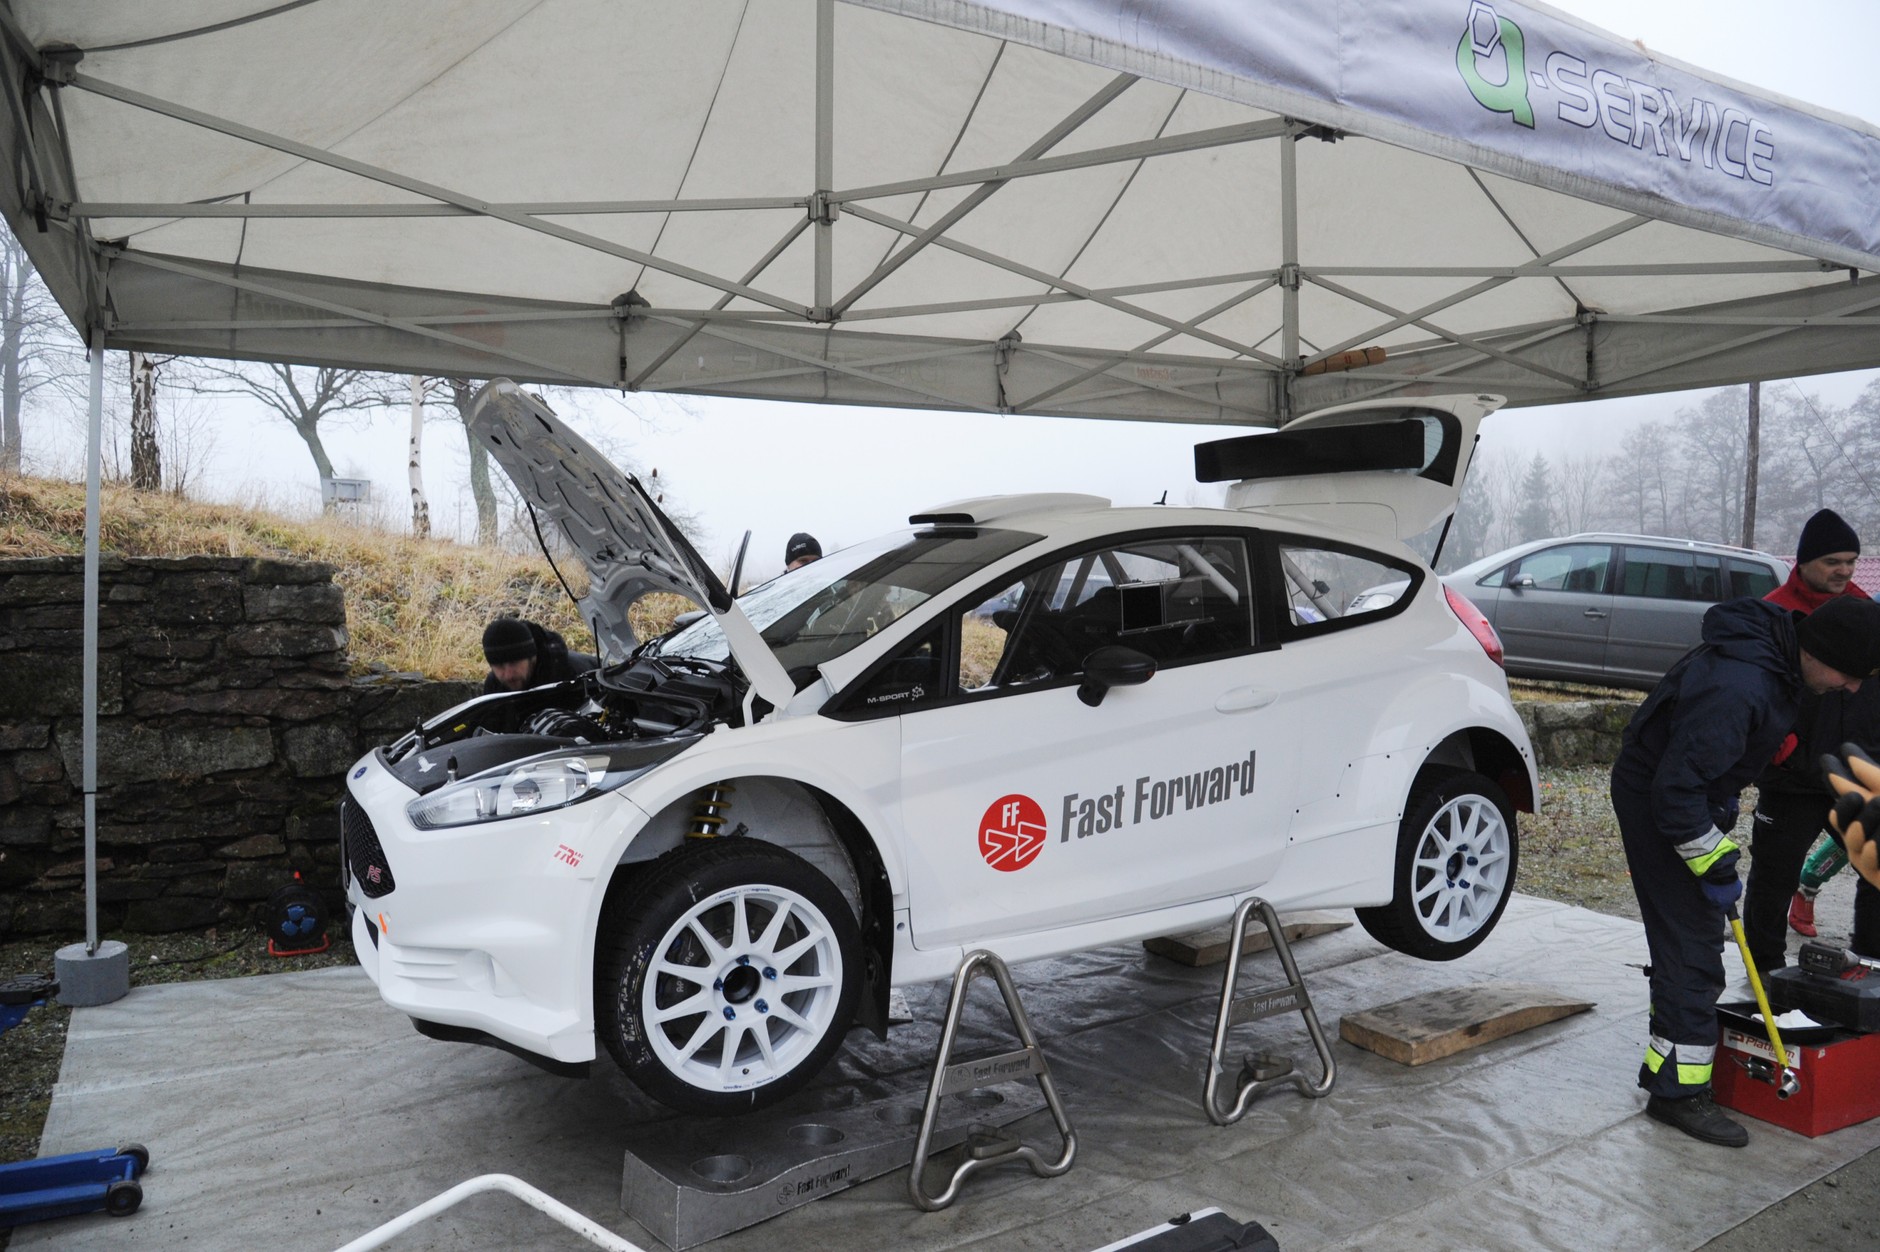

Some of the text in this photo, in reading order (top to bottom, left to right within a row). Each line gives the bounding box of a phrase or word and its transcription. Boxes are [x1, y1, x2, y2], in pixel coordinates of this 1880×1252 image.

[1456, 1, 1775, 186] Q-SERVICE
[867, 691, 909, 704] M-SPORT
[1060, 749, 1257, 844] Fast Forward
[1002, 801, 1020, 829] FF
[1746, 1036, 1795, 1059] Platim
[973, 1055, 1031, 1077] Fast Forward
[797, 1180, 814, 1196] Fast
